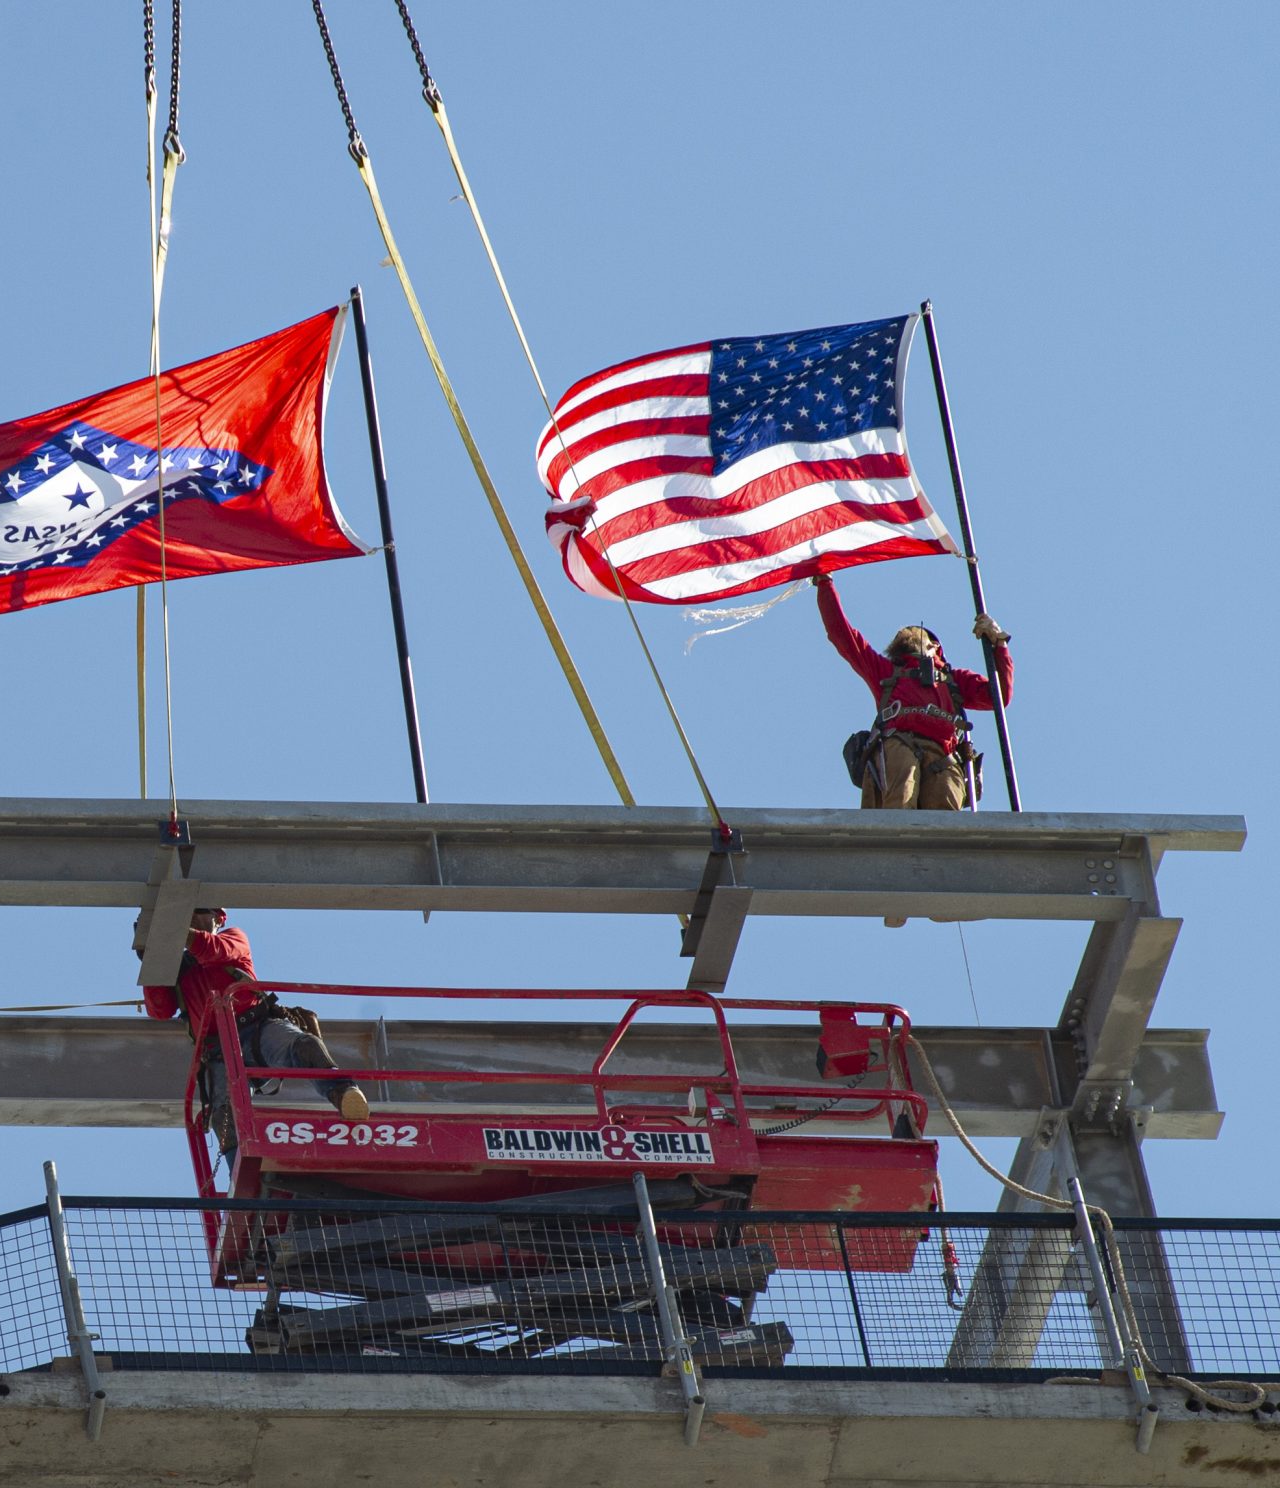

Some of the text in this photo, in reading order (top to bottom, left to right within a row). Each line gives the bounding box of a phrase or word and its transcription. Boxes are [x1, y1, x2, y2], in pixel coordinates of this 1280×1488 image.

[265, 1122, 419, 1147] GS-2032
[485, 1125, 711, 1160] BALDWIN & SHELL
[488, 1151, 713, 1162] CONSTRUCTION COMPANY
